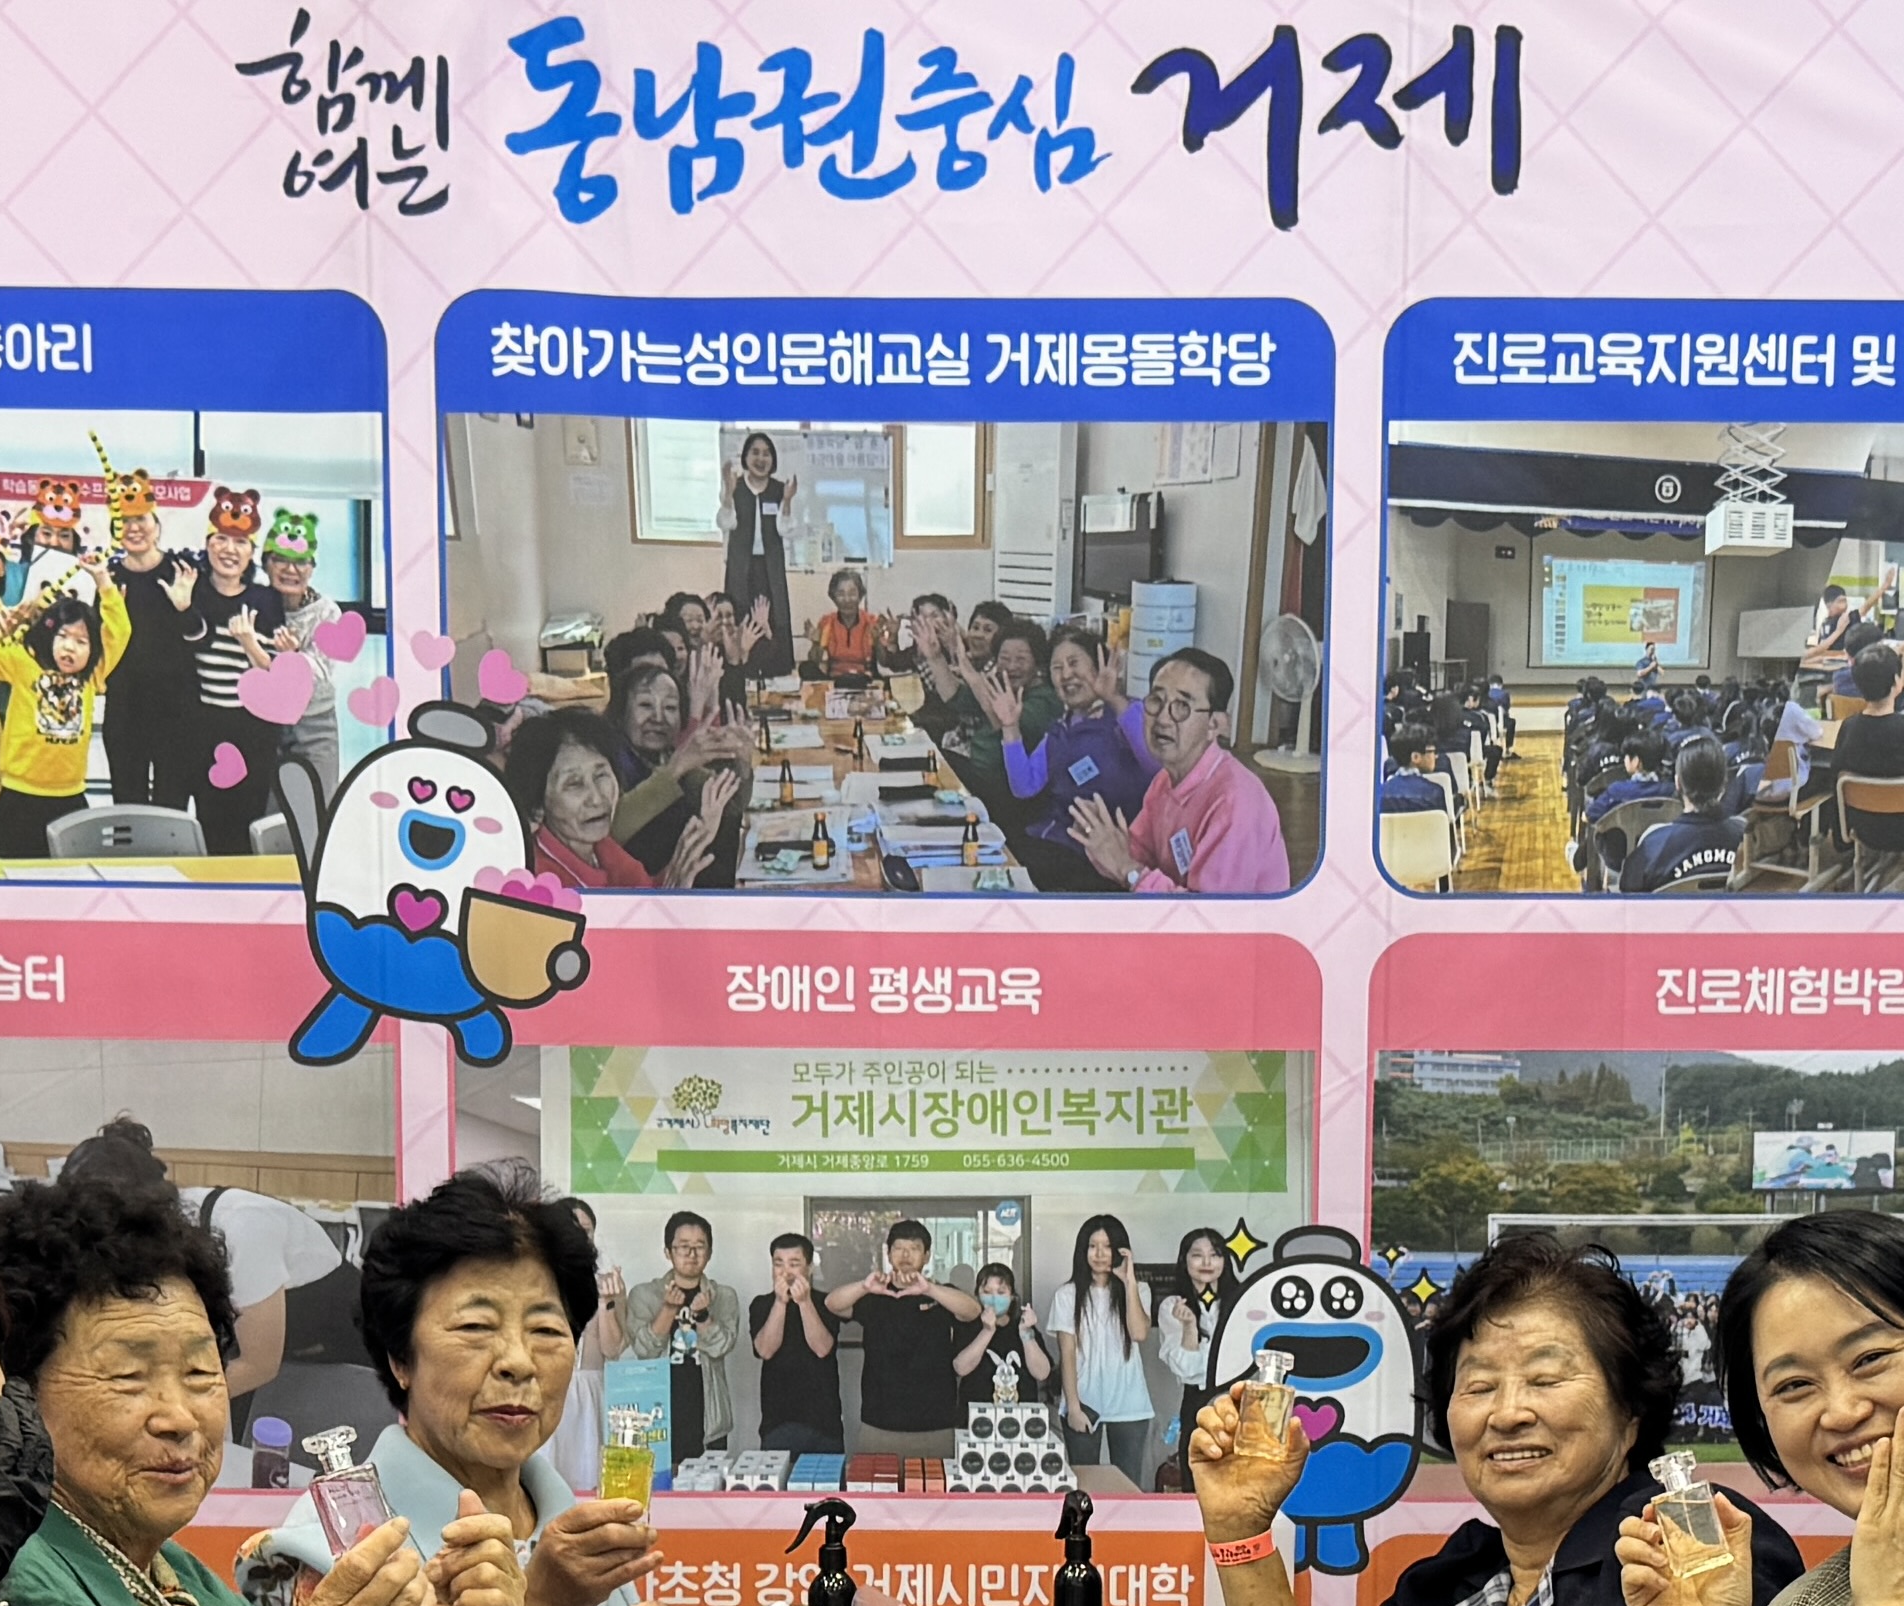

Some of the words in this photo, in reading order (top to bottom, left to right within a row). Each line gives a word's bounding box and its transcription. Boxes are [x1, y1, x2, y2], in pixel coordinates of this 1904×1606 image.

[236, 12, 450, 151] 함께
[506, 15, 1112, 225] 동남권중심
[1131, 23, 1525, 233] 거제
[283, 138, 451, 216] 여는
[490, 322, 971, 388] 찾아가는성인문해교실
[985, 329, 1276, 388] 거제몽돌학당
[1452, 331, 1836, 389] 진로교육지원센터
[1850, 333, 1896, 388] 및
[726, 964, 857, 1016] 장애인
[869, 964, 1044, 1017] 평생교육
[792, 1061, 855, 1085] 모두가
[862, 1060, 947, 1084] 주인공이
[955, 1059, 997, 1083] 되는
[790, 1086, 1194, 1139] 거제시장애인복지관
[778, 1153, 818, 1170] 거제시
[894, 1153, 930, 1169] 1759
[962, 1153, 1070, 1169] 055-636-4500
